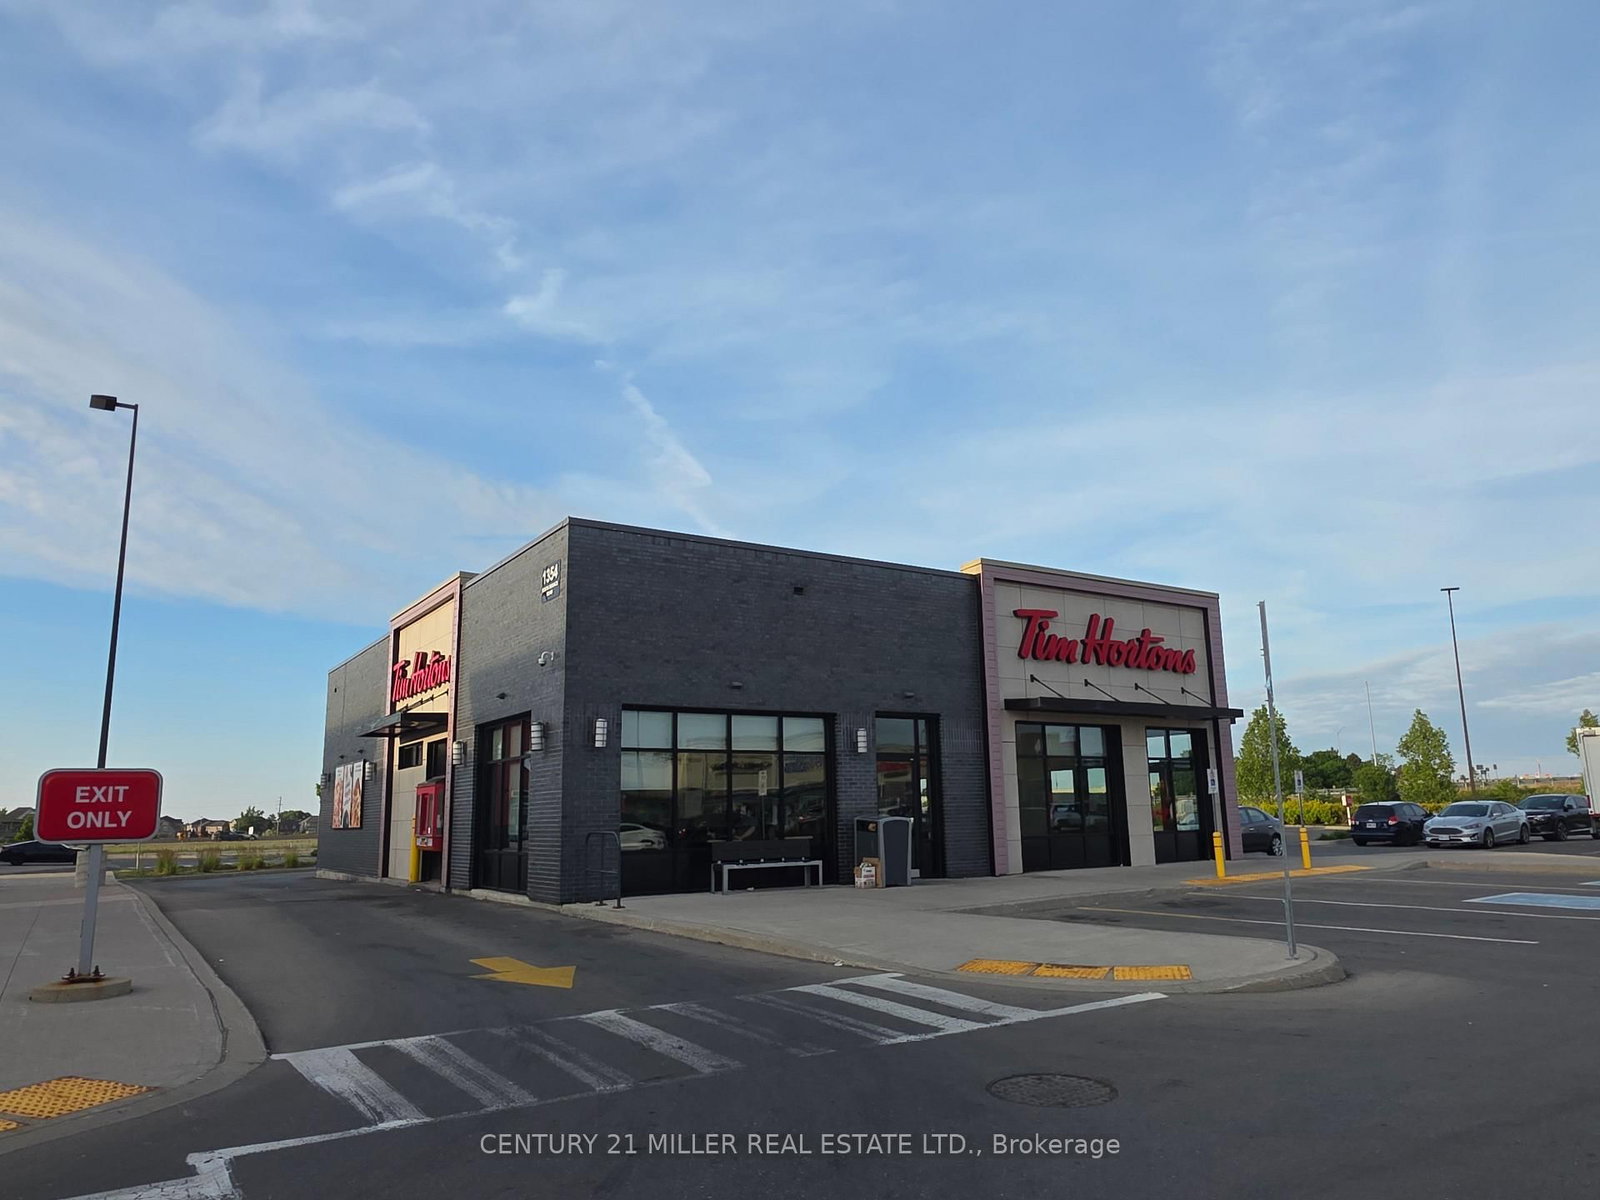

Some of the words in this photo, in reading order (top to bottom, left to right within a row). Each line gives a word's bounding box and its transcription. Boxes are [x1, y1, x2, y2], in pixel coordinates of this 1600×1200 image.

[542, 563, 559, 586] 1354
[1013, 609, 1079, 664] Tim
[1080, 613, 1196, 674] Hortons
[75, 785, 130, 803] EXIT
[66, 810, 133, 829] ONLY
